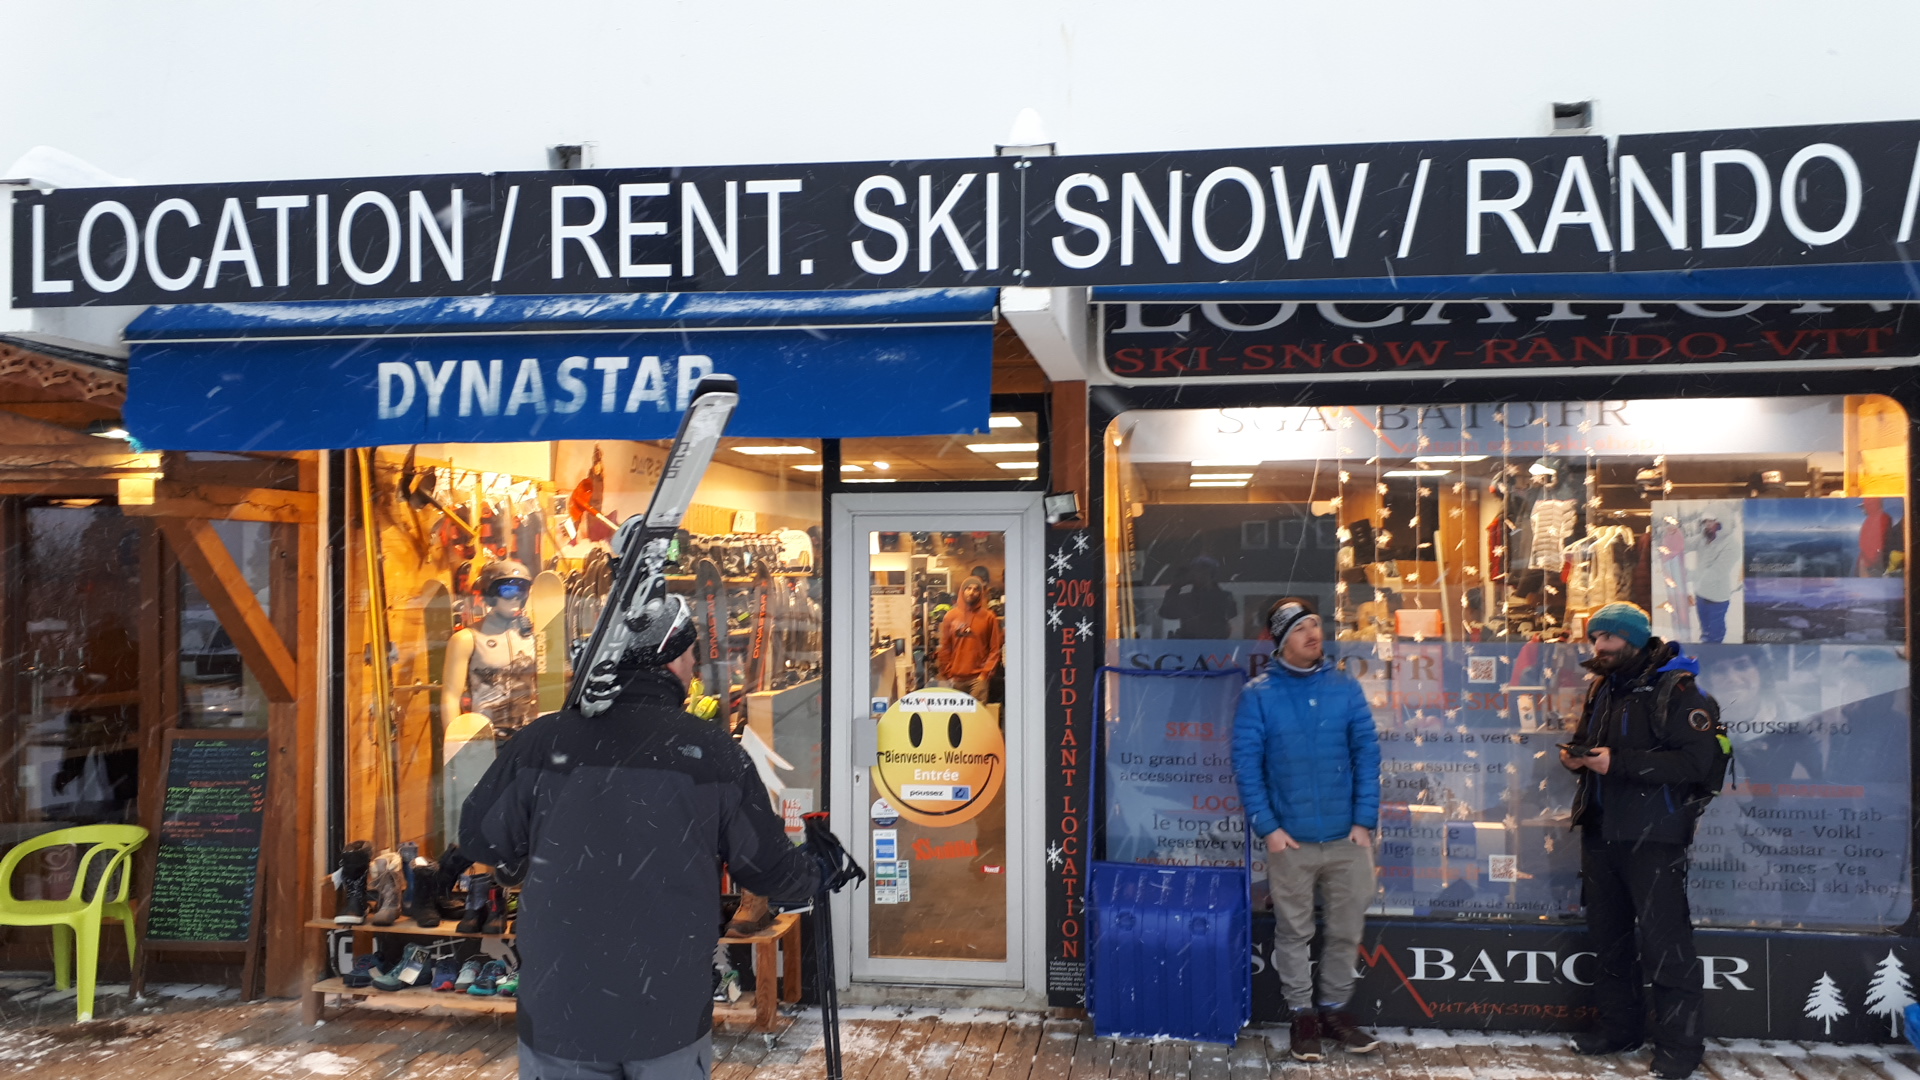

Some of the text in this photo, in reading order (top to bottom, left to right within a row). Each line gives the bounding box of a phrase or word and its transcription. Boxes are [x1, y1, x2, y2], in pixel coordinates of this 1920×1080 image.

[32, 189, 464, 293] LOCATION
[551, 179, 813, 280] RENT.
[851, 172, 999, 276] SKI
[1051, 162, 1369, 270] SNOW
[1466, 143, 1862, 255] RANDO
[1114, 327, 1893, 373] SKI-SNOW-RANDO-VTT
[1048, 579, 1095, 608] -20%
[707, 594, 719, 659] DYNASTAR
[753, 594, 768, 659] DYNASTAR
[1468, 692, 1510, 711] SKI
[1165, 722, 1213, 738] SKIS
[1726, 720, 1800, 735] ROUSSE
[885, 751, 936, 764] Bienvenue
[944, 751, 990, 765] Welcome
[1120, 752, 1143, 765] Un
[1149, 752, 1197, 768] grand
[914, 769, 960, 782] Entrée
[1120, 771, 1213, 784] accessoires
[910, 789, 945, 797] poussez
[1060, 627, 1079, 958] ETUDIANT LOCATION
[1153, 813, 1171, 831] le
[1177, 816, 1211, 835] top
[1813, 825, 1862, 839] Volkl
[1157, 837, 1228, 849] Reserver
[1835, 862, 1866, 876] Yes
[1732, 877, 1816, 893] technical
[1823, 881, 1849, 894] ski
